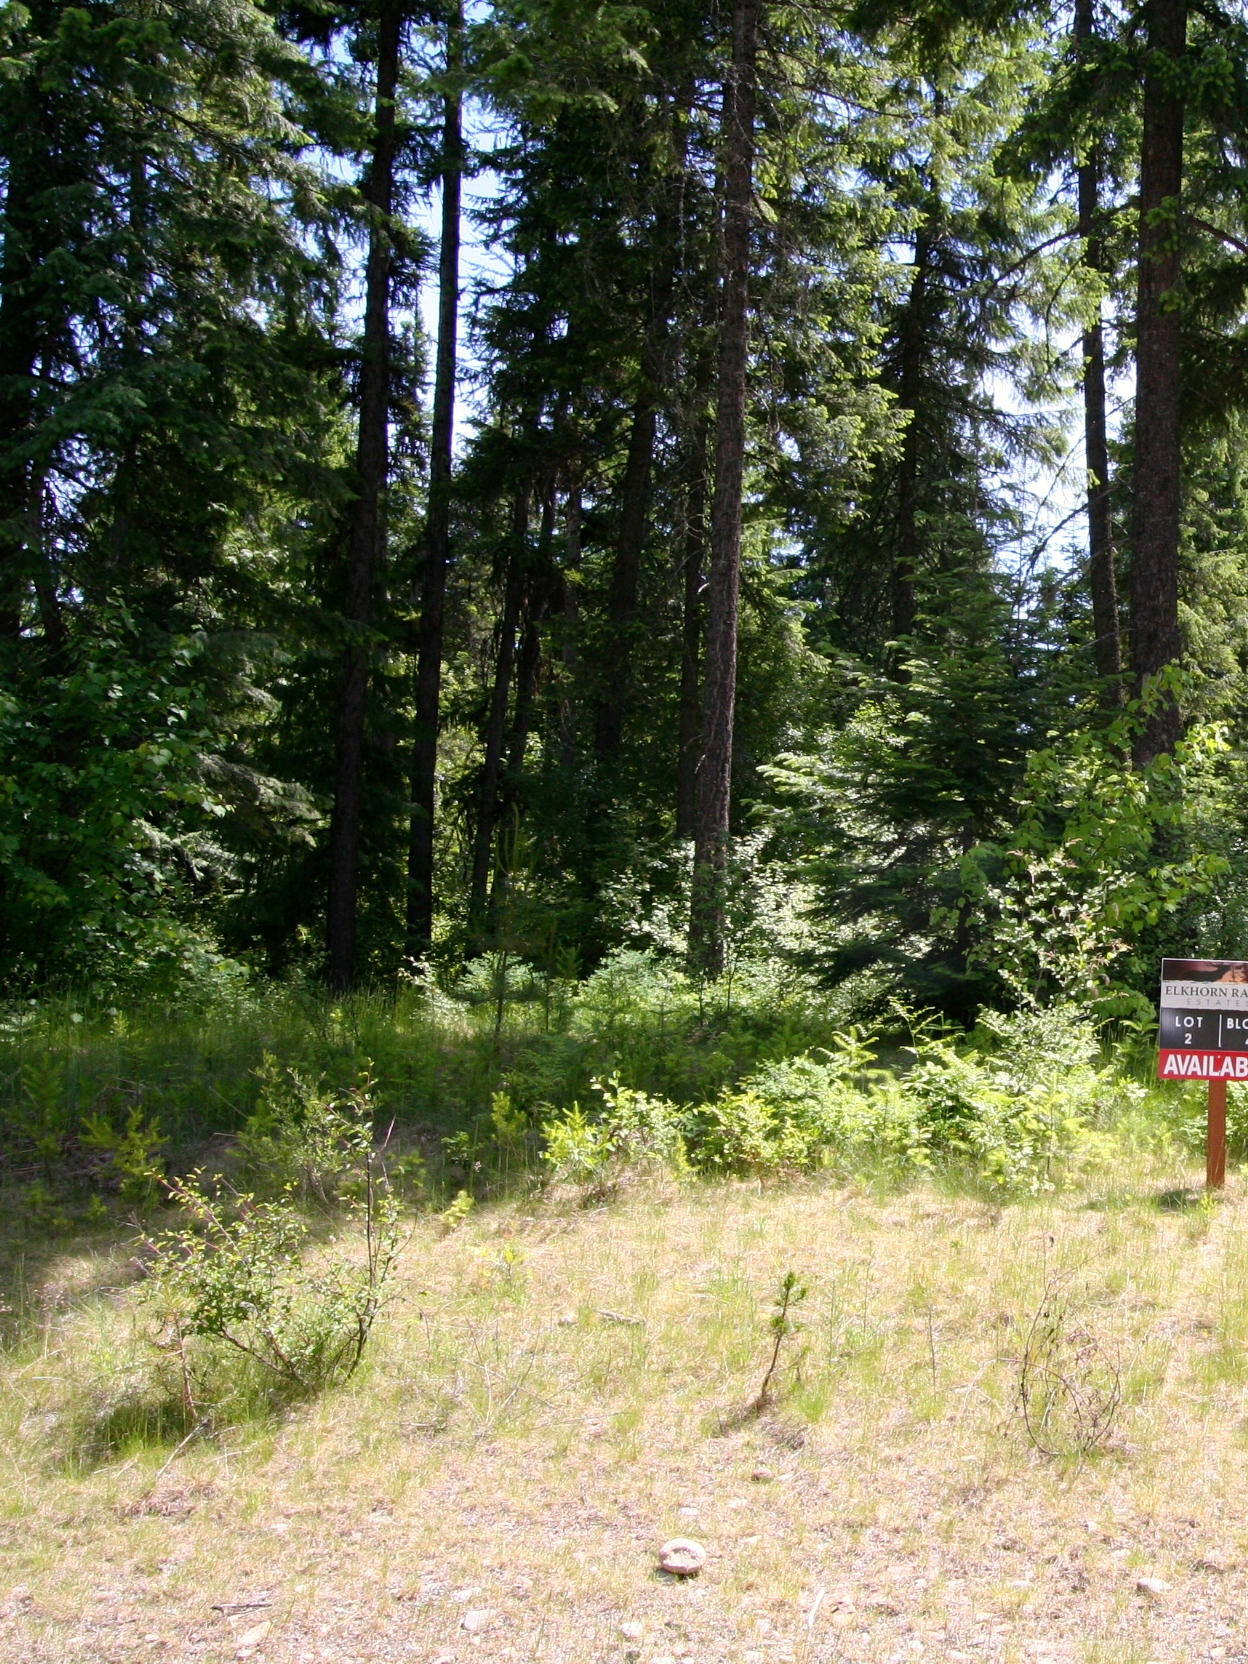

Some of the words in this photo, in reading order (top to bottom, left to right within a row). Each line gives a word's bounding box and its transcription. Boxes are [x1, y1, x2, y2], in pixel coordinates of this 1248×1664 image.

[1165, 986, 1228, 997] ELKHORN
[1175, 1015, 1203, 1028] LOT
[1184, 1033, 1192, 1044] 2
